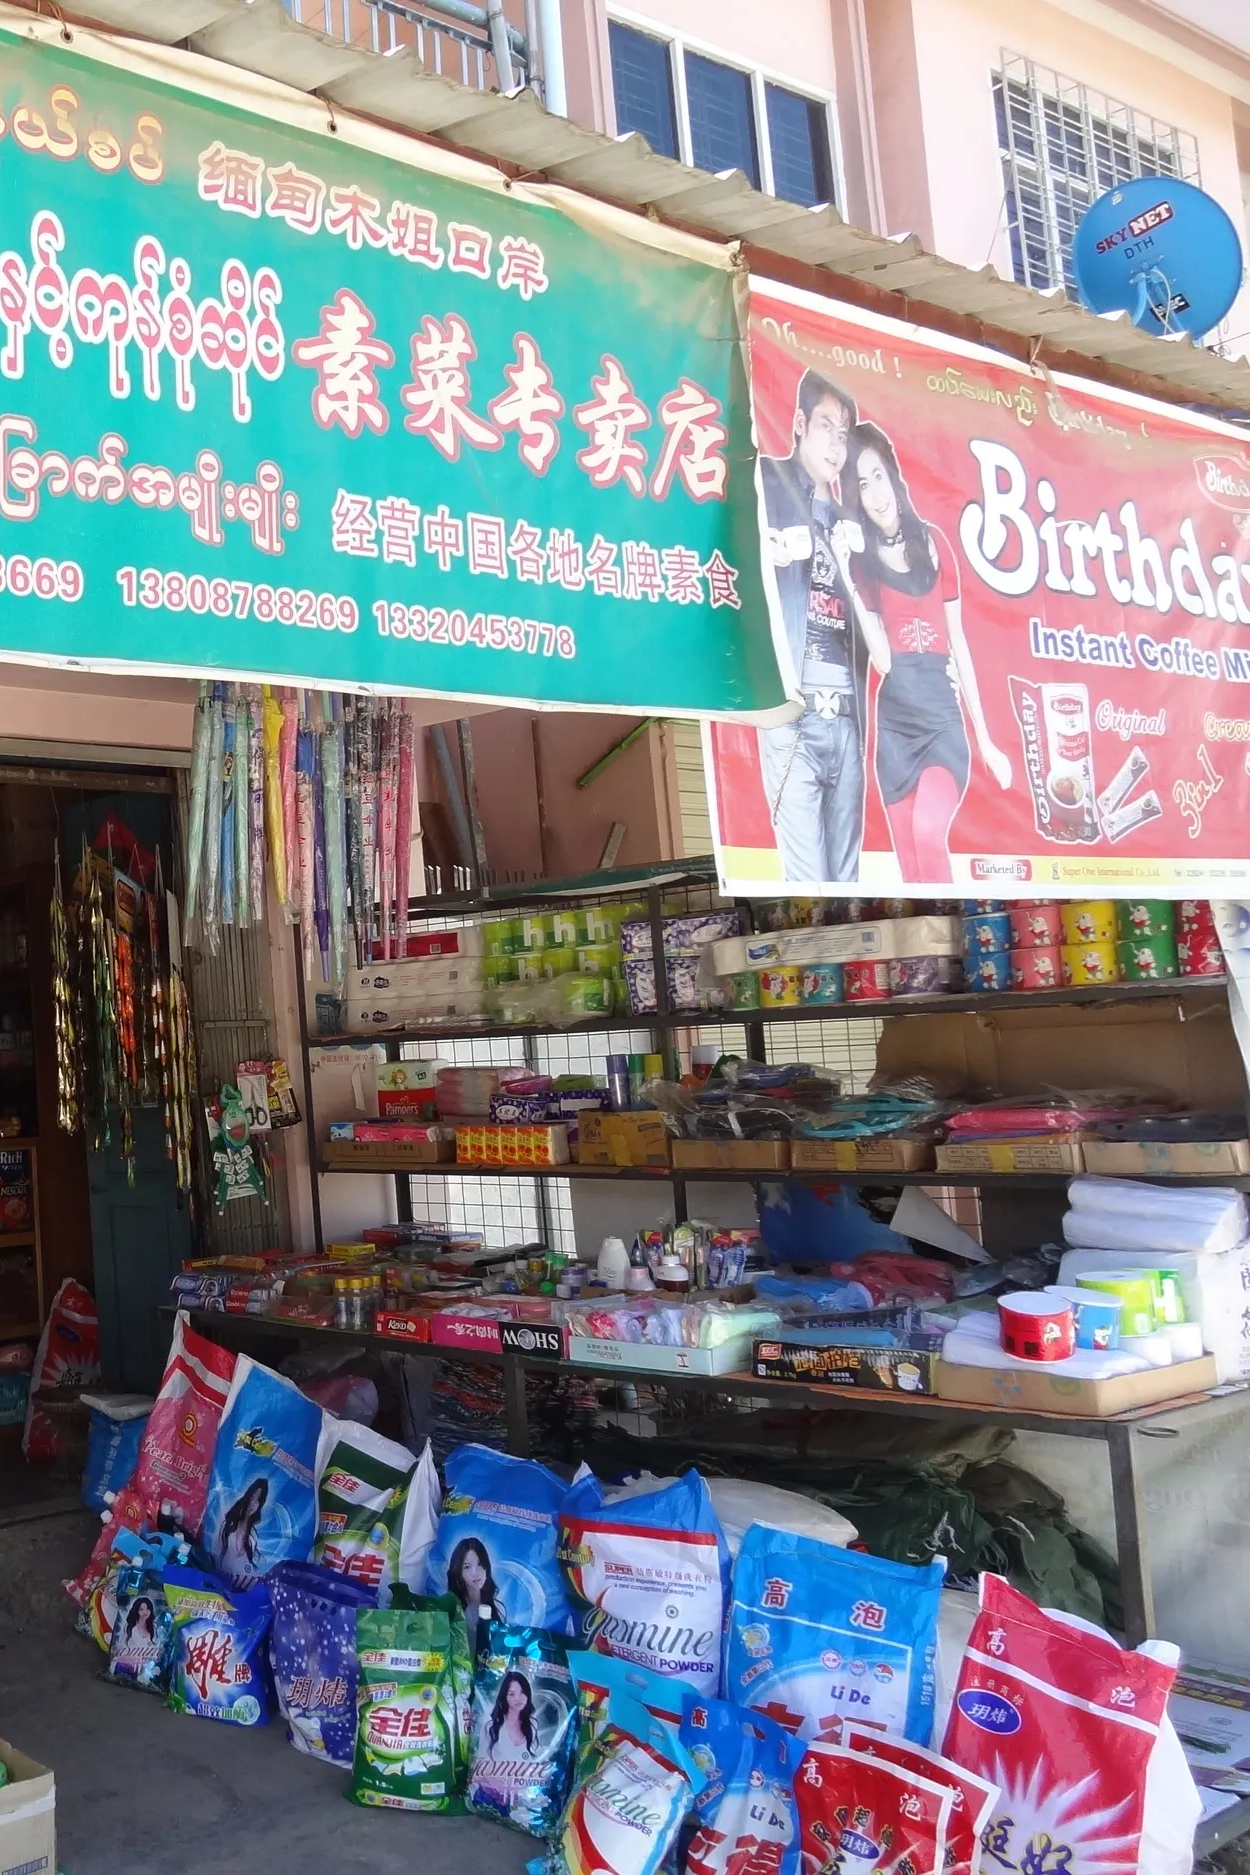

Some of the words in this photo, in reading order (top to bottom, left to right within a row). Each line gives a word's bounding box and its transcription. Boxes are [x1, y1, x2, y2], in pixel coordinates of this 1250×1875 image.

[198, 141, 549, 299] 缅甸木姐口岸
[1124, 236, 1155, 259] DTH
[294, 288, 730, 504] 素菜专卖店
[959, 439, 1250, 624] Birthda
[332, 489, 743, 611] 经营中国各地名牌素食
[117, 566, 358, 632] 13808788269
[373, 600, 576, 659] 13320453778
[1029, 617, 1136, 668] Instant
[1135, 633, 1220, 680] Coffee
[1094, 699, 1166, 753] Original
[975, 861, 1013, 877] Marketed
[385, 1101, 419, 1117] Pampers
[503, 1328, 559, 1350] SHOW
[604, 1563, 634, 1576] SUPER
[761, 1577, 794, 1610] 高
[850, 1599, 888, 1632] 泡
[659, 1658, 715, 1673] POWDER
[986, 1628, 1007, 1656] 高
[1109, 1685, 1136, 1708] 泡
[829, 1684, 845, 1700] Li
[849, 1688, 871, 1706] De
[368, 1706, 432, 1738] 全佳
[366, 1730, 403, 1750] QUANJIA
[513, 1777, 551, 1788] POWDER
[899, 1792, 922, 1822] 泡
[614, 1811, 653, 1837] POWDER
